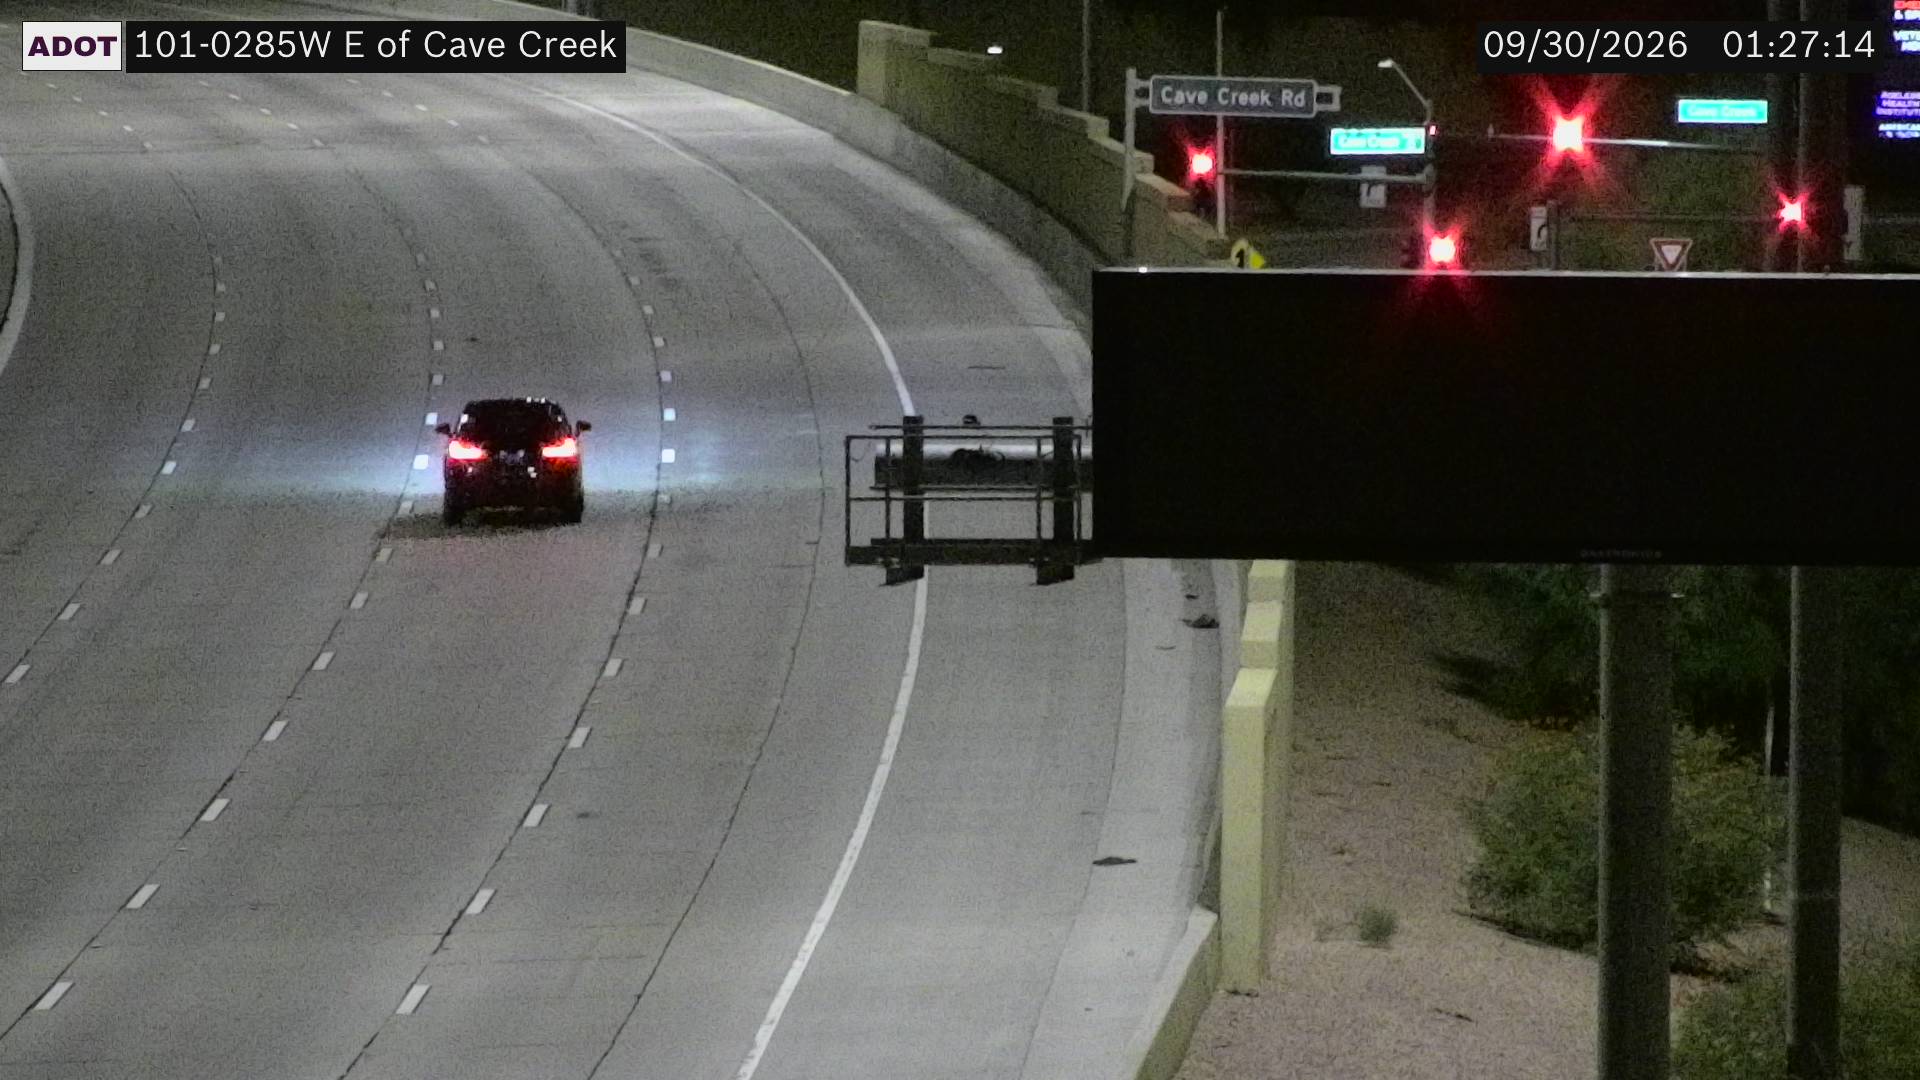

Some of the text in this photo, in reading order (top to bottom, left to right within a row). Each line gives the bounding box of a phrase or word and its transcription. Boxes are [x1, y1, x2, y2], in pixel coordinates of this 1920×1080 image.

[1160, 87, 1306, 107] Cave Creek Rd
